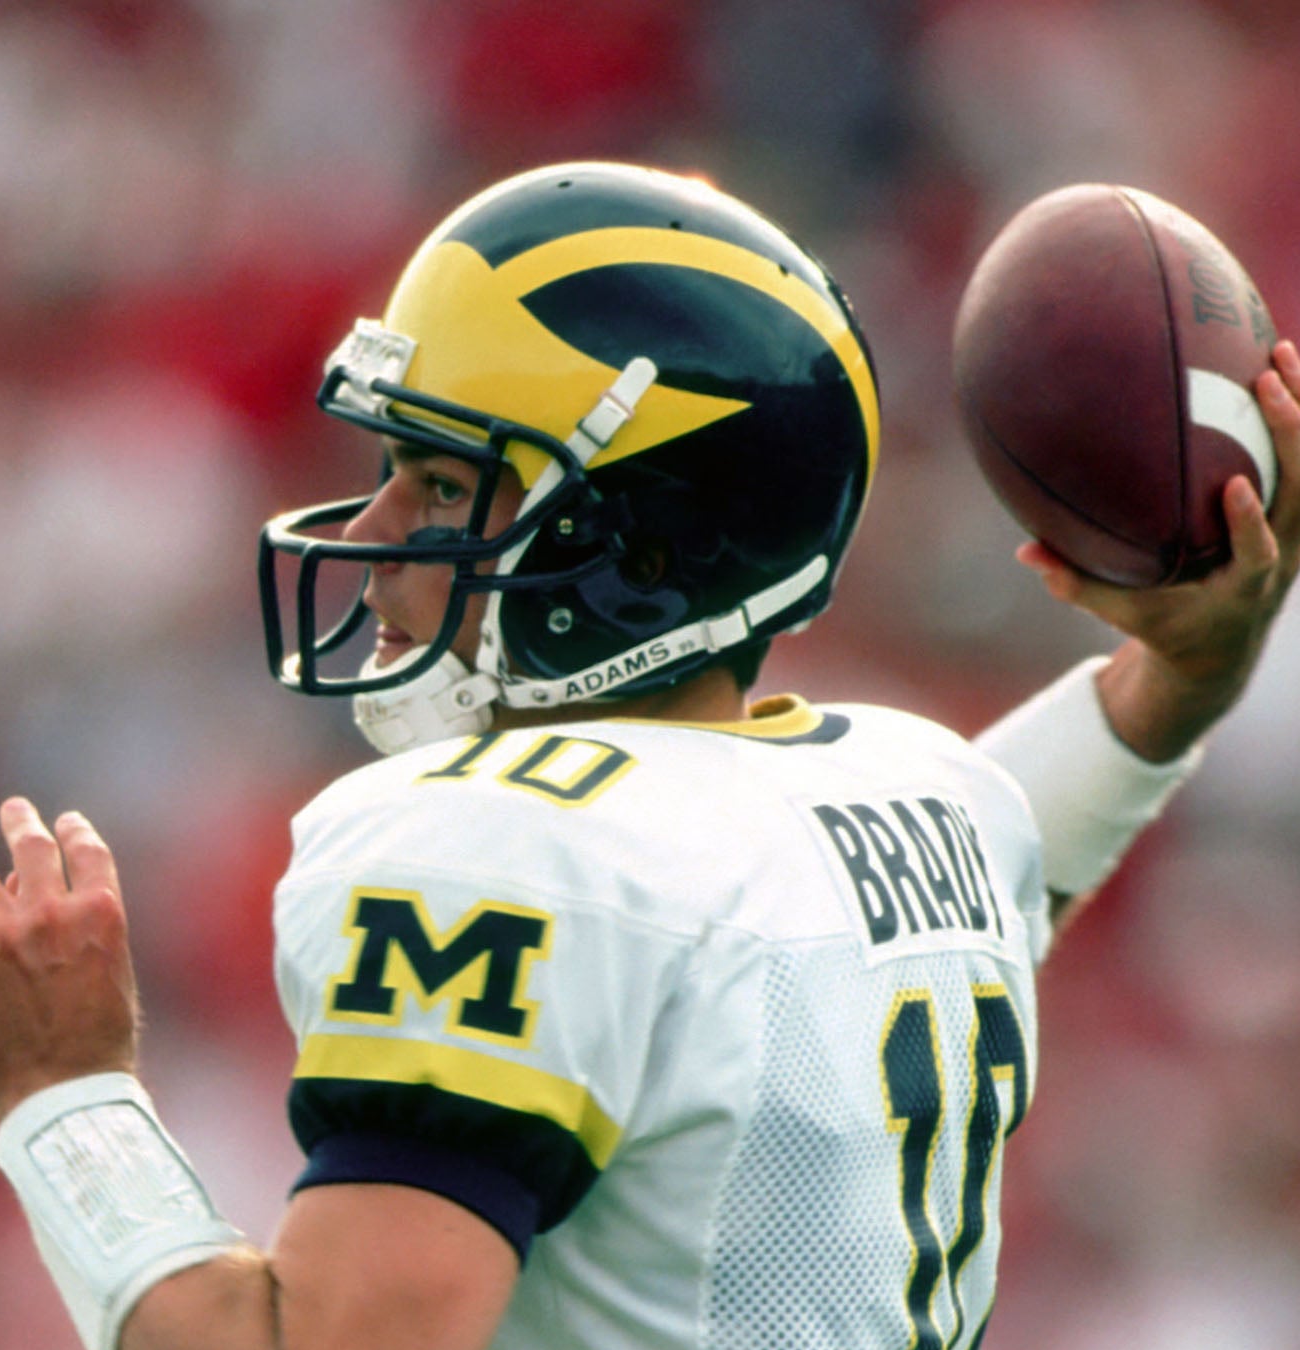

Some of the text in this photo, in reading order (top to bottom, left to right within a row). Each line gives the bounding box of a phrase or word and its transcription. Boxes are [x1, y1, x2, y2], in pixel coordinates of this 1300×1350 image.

[564, 641, 671, 698] ADAMS
[413, 733, 640, 808] 10
[323, 885, 556, 1052] M
